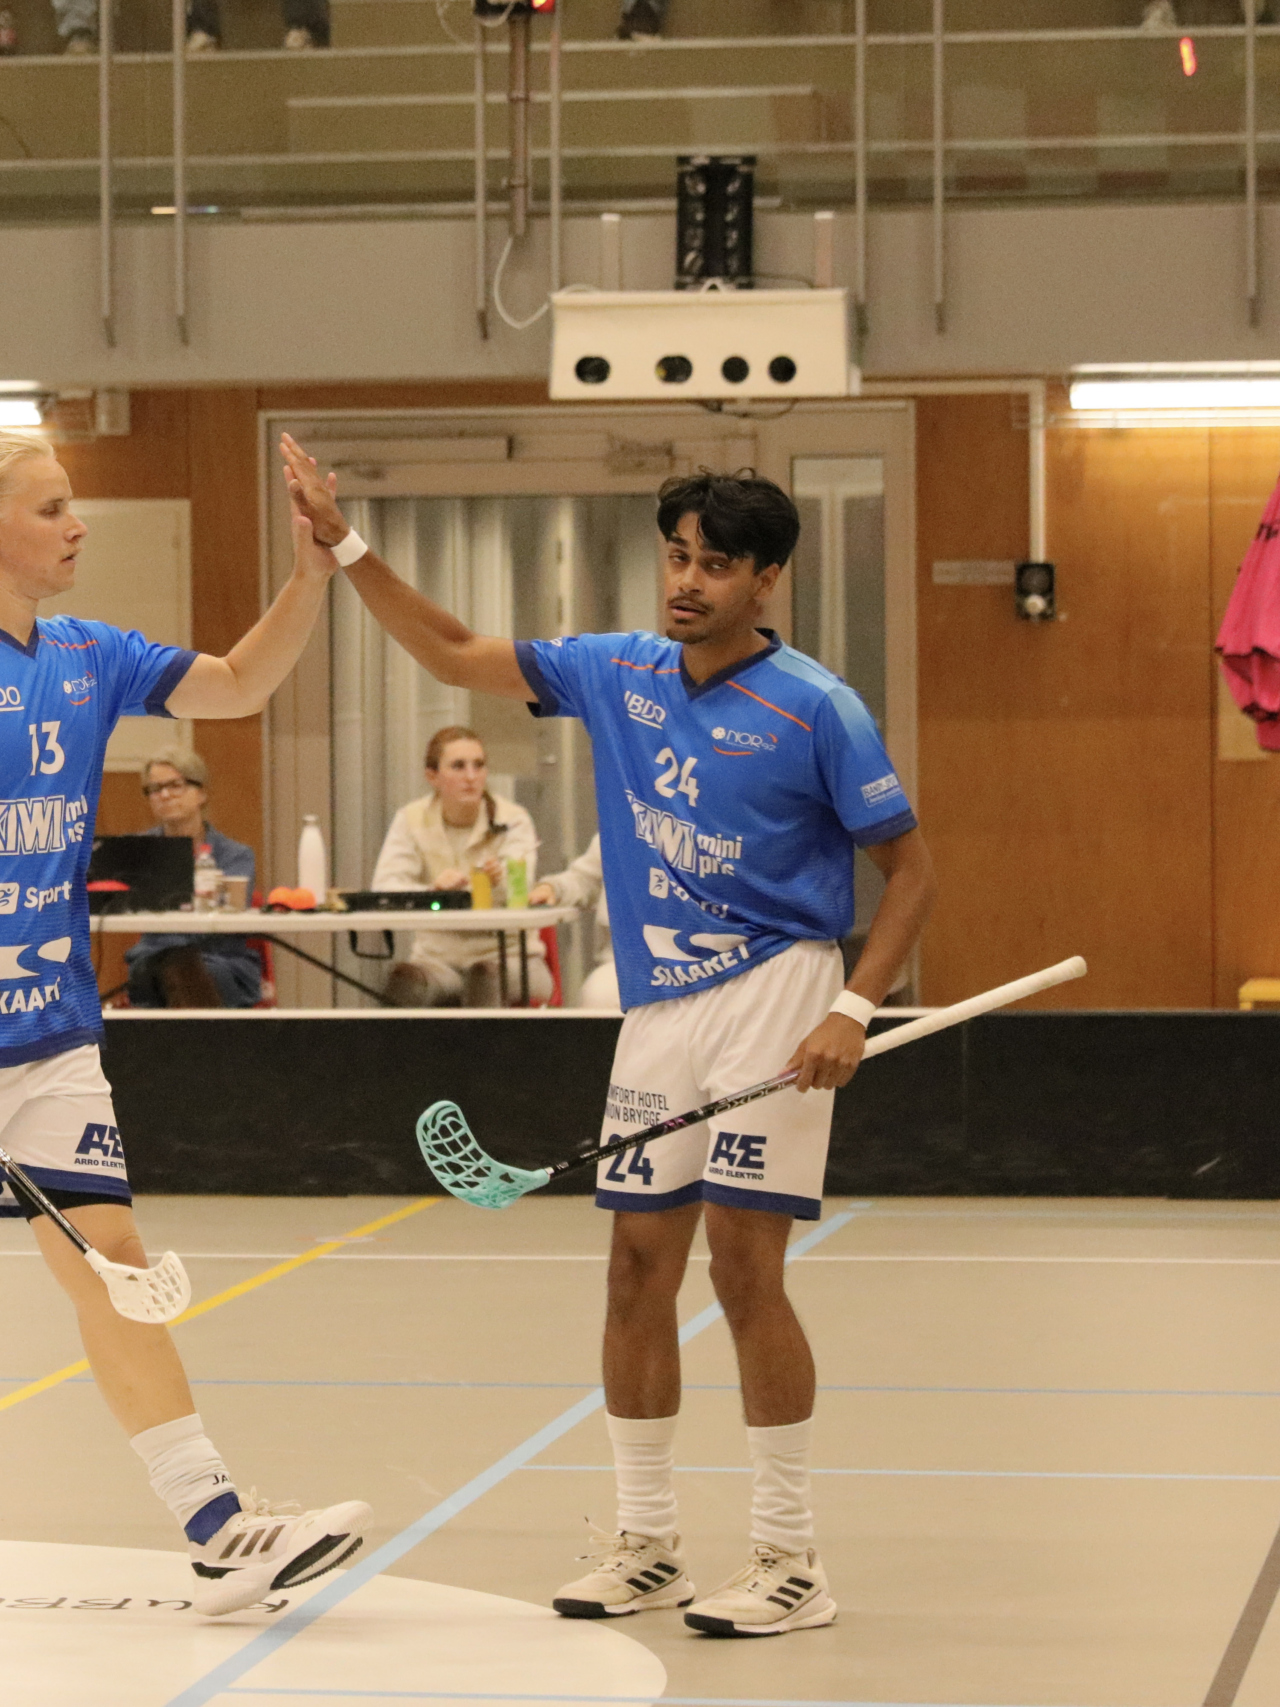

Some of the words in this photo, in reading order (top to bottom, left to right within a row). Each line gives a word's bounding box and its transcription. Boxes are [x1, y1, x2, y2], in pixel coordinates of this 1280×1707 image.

[29, 720, 65, 776] 13
[654, 747, 700, 807] 24
[696, 833, 743, 859] mini
[637, 1091, 670, 1111] HOTEL
[622, 1106, 661, 1127] BRYGGE
[74, 1157, 99, 1166] ARRO
[604, 1133, 654, 1187] 24
[725, 1169, 765, 1181] ELEKTRO
